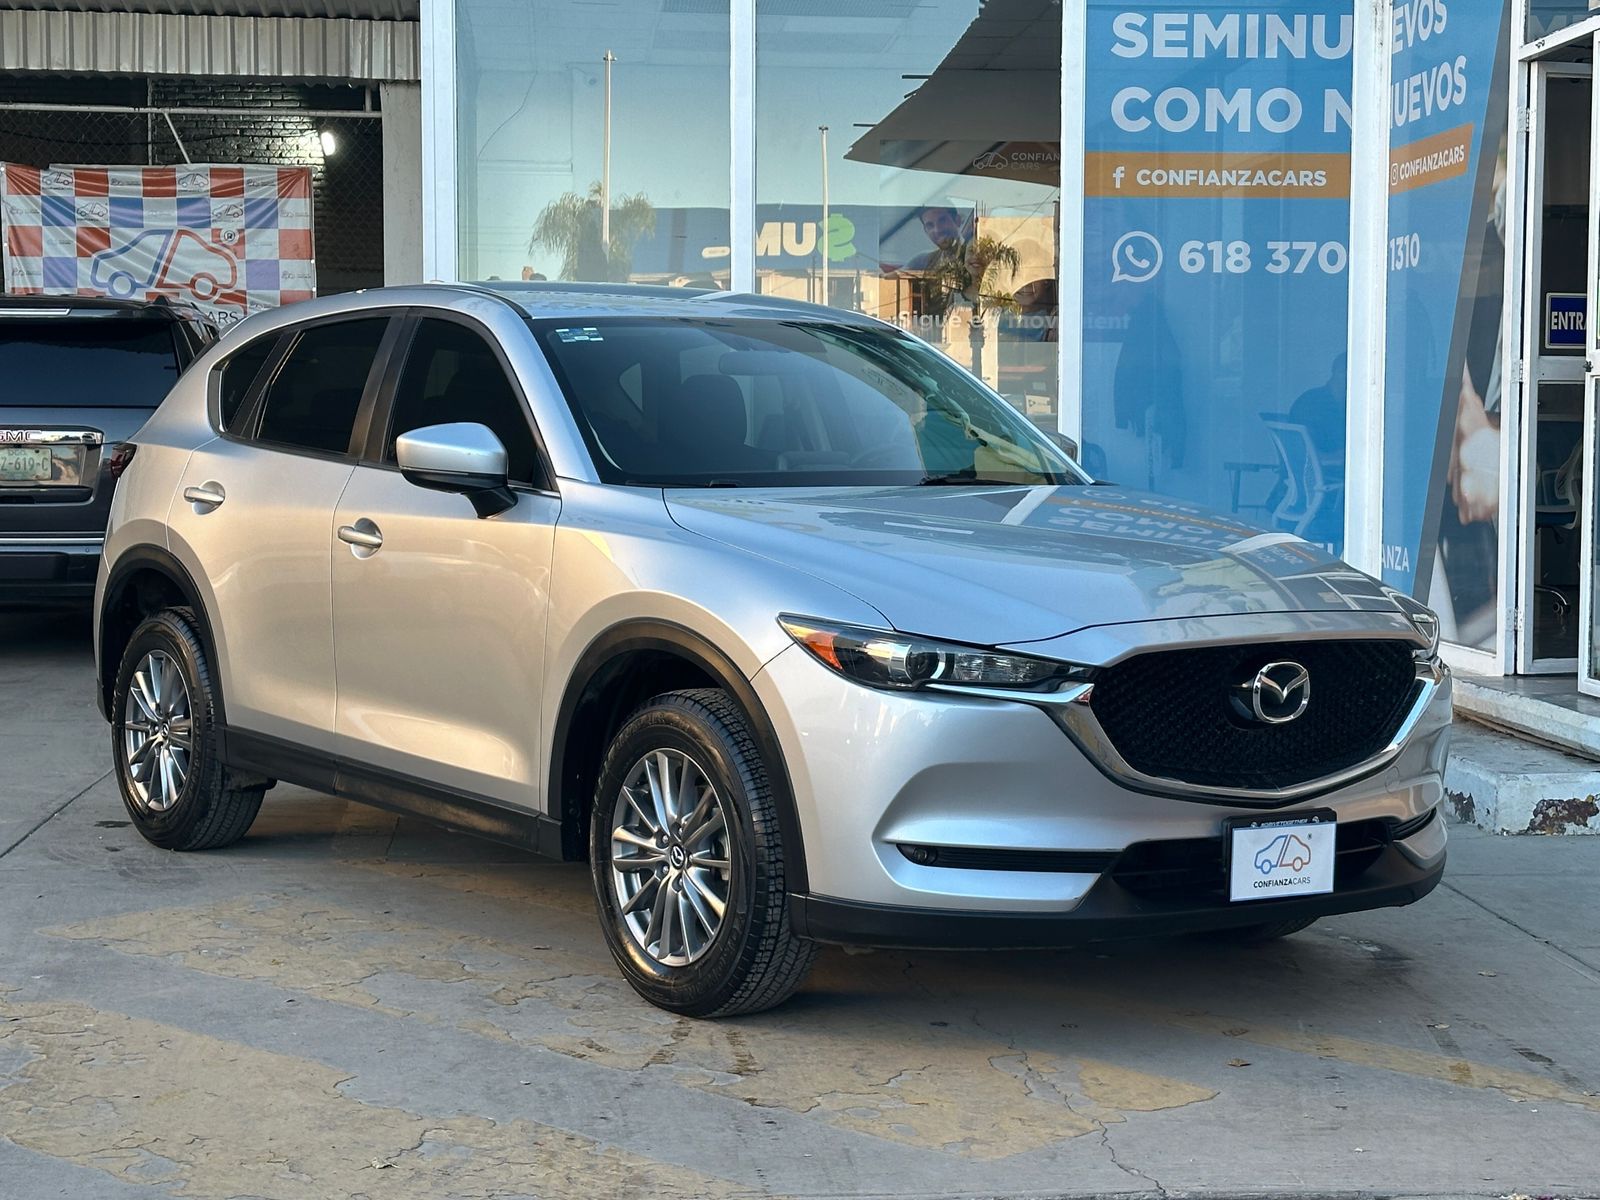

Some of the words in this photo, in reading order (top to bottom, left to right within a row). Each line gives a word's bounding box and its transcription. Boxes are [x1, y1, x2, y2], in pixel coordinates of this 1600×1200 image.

[1111, 86, 1302, 132] COMO
[1390, 55, 1467, 129] UEVOS
[1136, 169, 1327, 187] CONFIANZACARS
[1399, 144, 1465, 180] CONFIANZACARS
[1179, 240, 1252, 274] 618
[1264, 240, 1347, 274] 370
[1389, 233, 1420, 271] 1310
[1253, 877, 1311, 889] CONFIANZACARS
